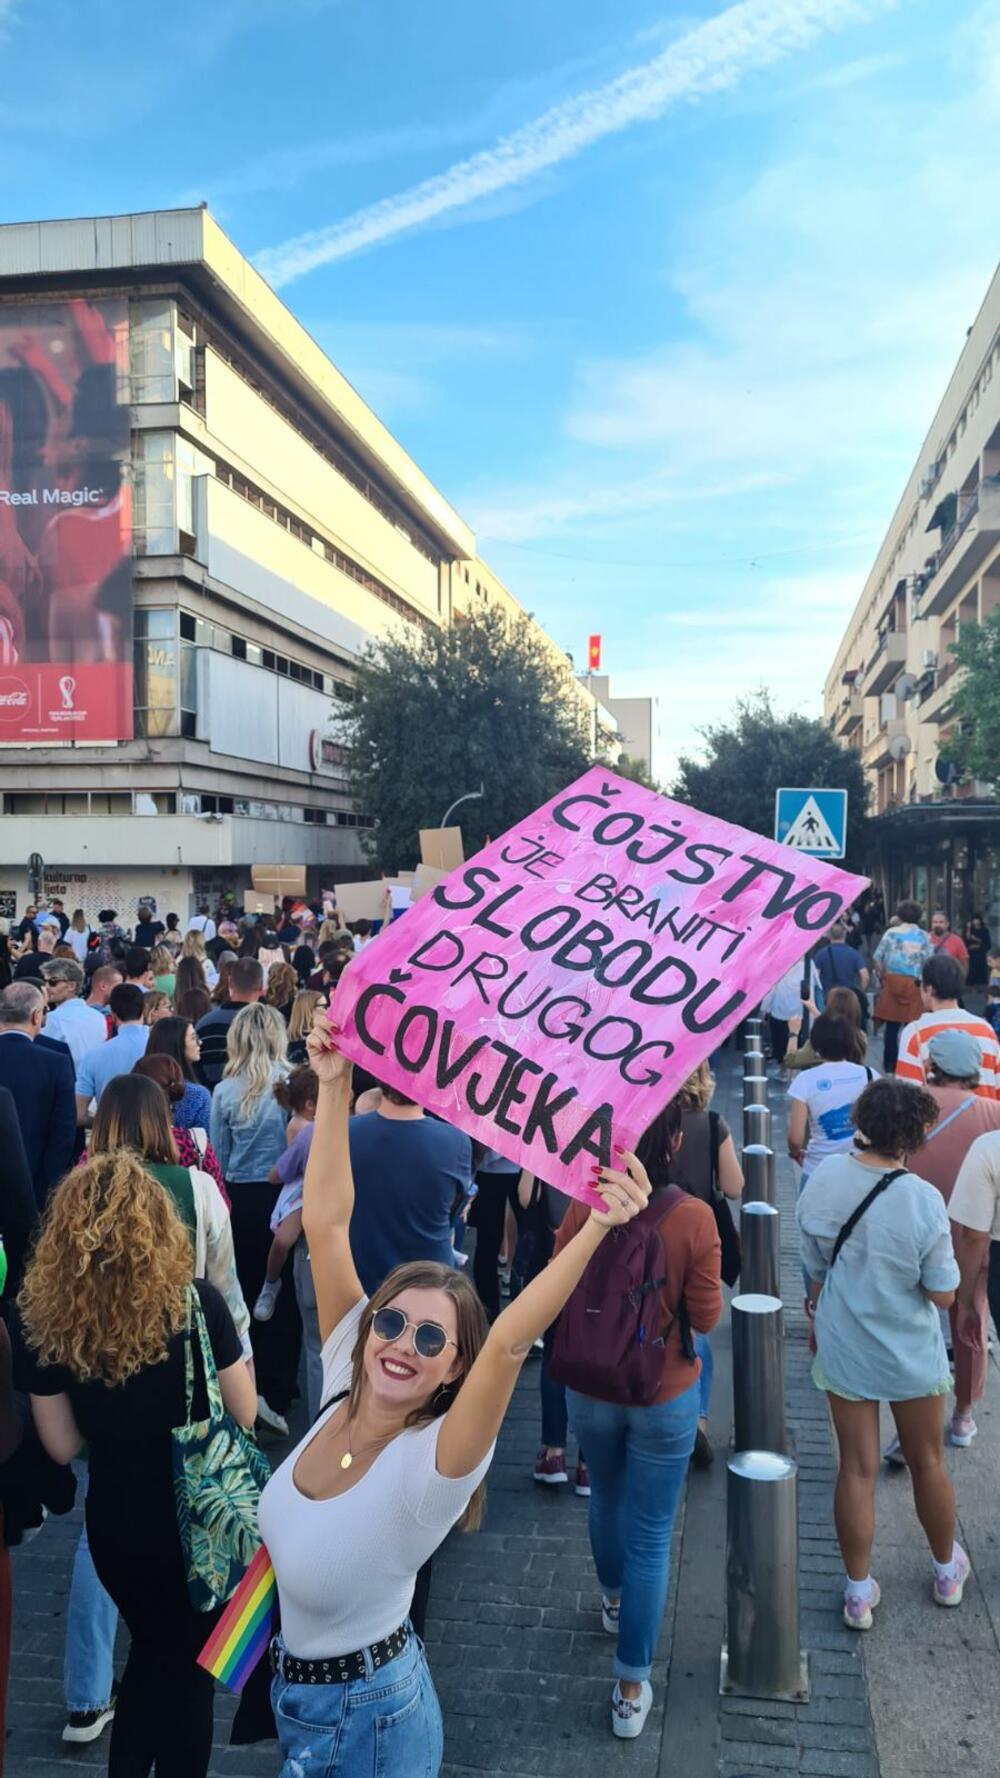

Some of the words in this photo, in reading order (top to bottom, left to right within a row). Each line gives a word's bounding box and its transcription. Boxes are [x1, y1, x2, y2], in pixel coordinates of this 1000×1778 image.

[0, 489, 39, 505] Real
[44, 872, 87, 883] kulturno
[44, 884, 66, 896] ljeto
[501, 835, 566, 878] JE
[574, 873, 752, 963] BRANITI
[552, 782, 843, 930] ČOJSTVO
[408, 930, 675, 1087] DRUGOG
[435, 867, 746, 1033] SLOBODU
[354, 968, 615, 1178] ČOVJEKA
